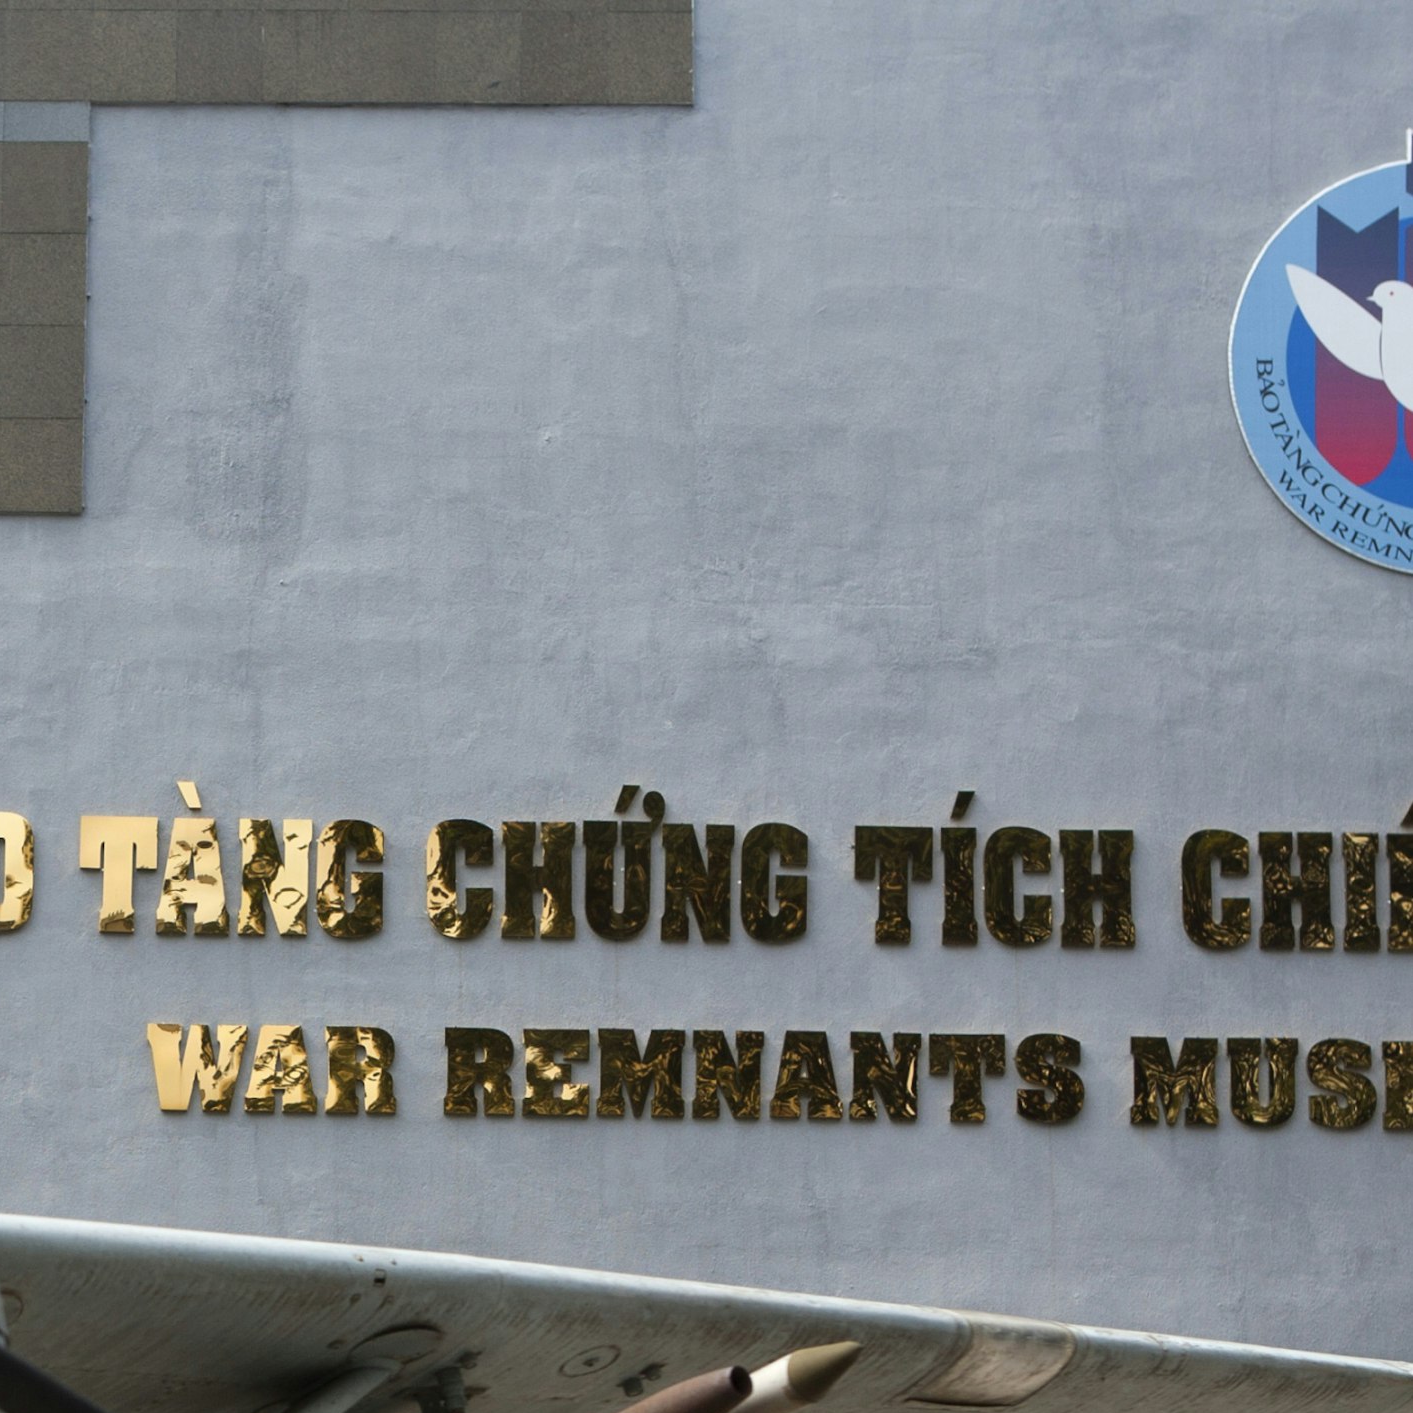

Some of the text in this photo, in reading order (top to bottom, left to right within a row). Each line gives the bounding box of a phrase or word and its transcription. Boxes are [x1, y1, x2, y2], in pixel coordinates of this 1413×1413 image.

[1256, 358, 1286, 413] BẢO
[1270, 413, 1324, 487] TÀNG
[1279, 470, 1326, 524] WAR
[79, 780, 387, 939] TÀNG
[426, 784, 809, 945] CHỨNG
[852, 790, 1137, 950] TÍCH
[147, 1022, 397, 1117] WAR
[443, 1026, 1086, 1125] REMNANTS
